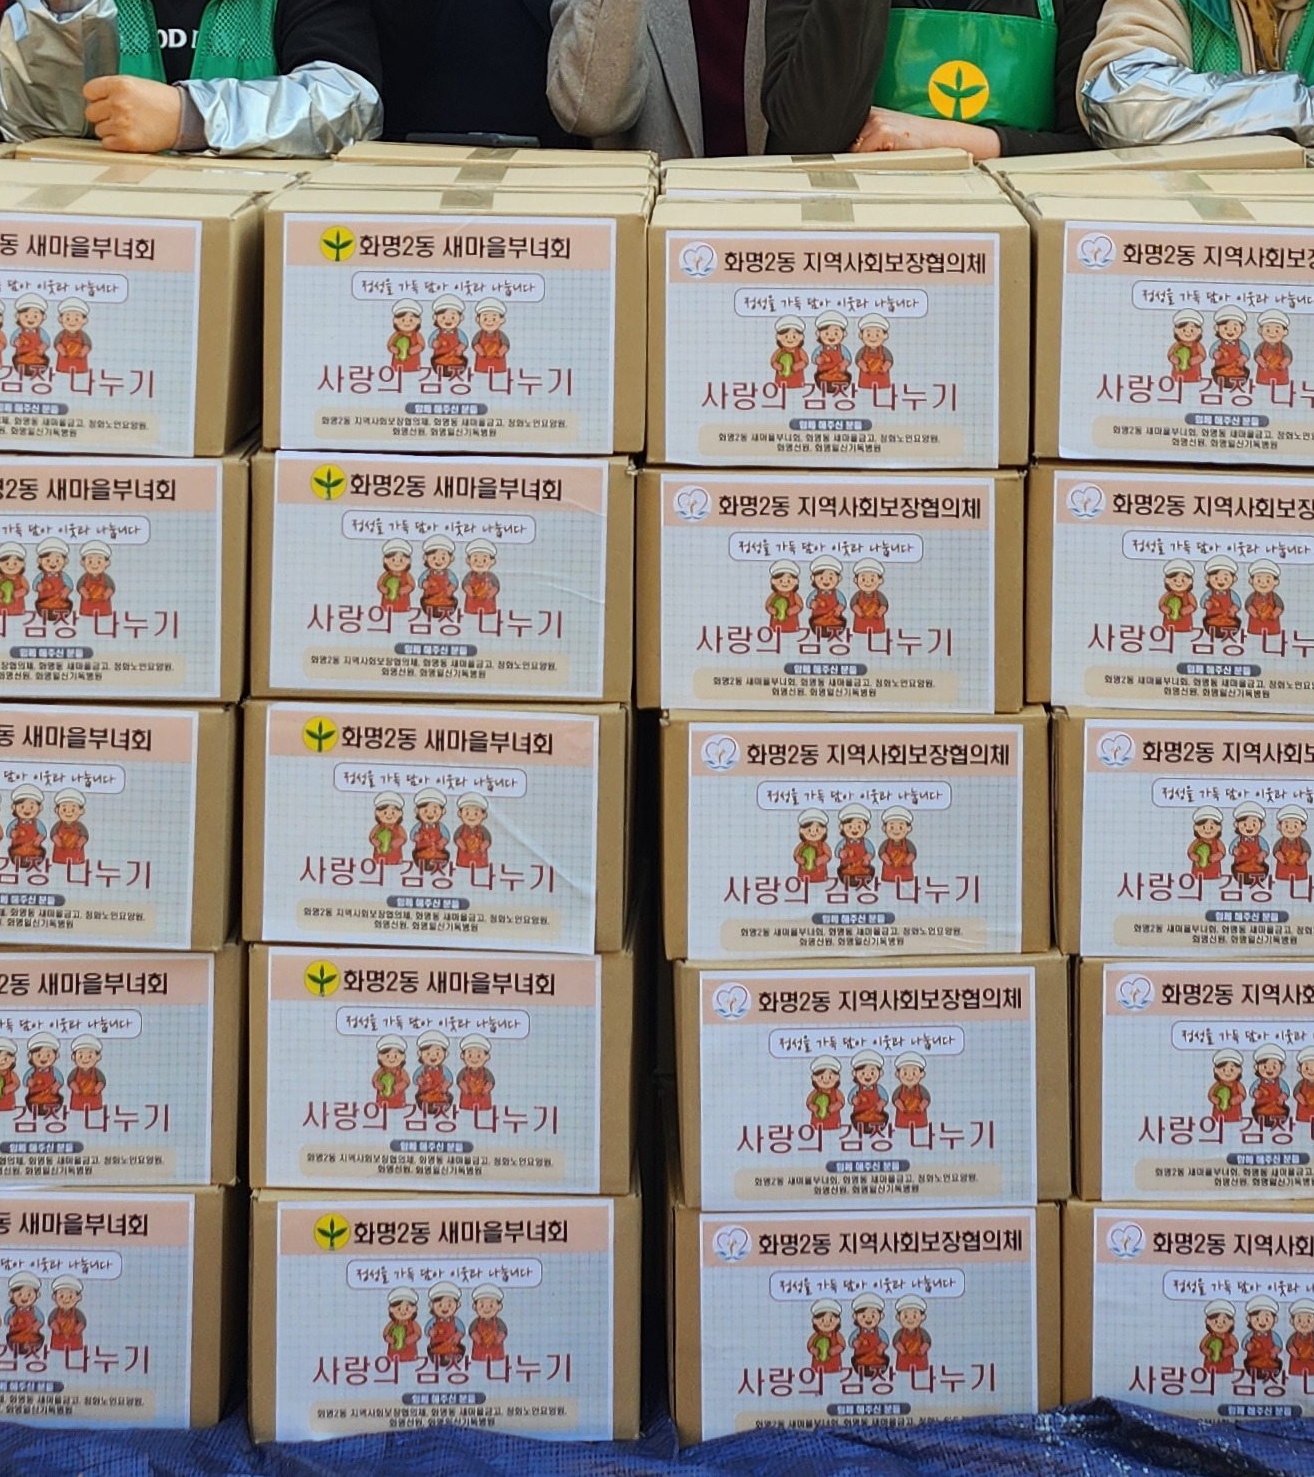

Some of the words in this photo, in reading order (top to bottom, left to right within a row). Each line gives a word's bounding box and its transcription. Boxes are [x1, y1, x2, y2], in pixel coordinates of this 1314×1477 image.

[359, 234, 435, 258] 화명2동
[443, 235, 571, 261] 새마을부녀회
[317, 364, 403, 395] 사랑의
[418, 365, 474, 395] 김장
[487, 366, 573, 397] 나누기
[718, 495, 790, 518] 화명2동
[797, 496, 980, 520] 지역사회보장협의체
[23, 724, 152, 753] 새마을부녀회
[747, 744, 819, 766] 화명2동
[826, 744, 1008, 766] 지역사회보장협의체
[65, 858, 152, 890] 나누기
[724, 876, 809, 904] 사랑의
[825, 877, 881, 904] 김장
[895, 875, 980, 904] 나누기
[1161, 983, 1233, 1006] 화명2동
[1139, 1116, 1224, 1145] 사랑의
[1240, 1117, 1296, 1144] 김장
[354, 1222, 431, 1245] 화명2동
[439, 1221, 569, 1244] 새마을부녀회
[758, 1233, 831, 1256] 화명2동
[838, 1230, 1022, 1255] 지역사회보장협의체
